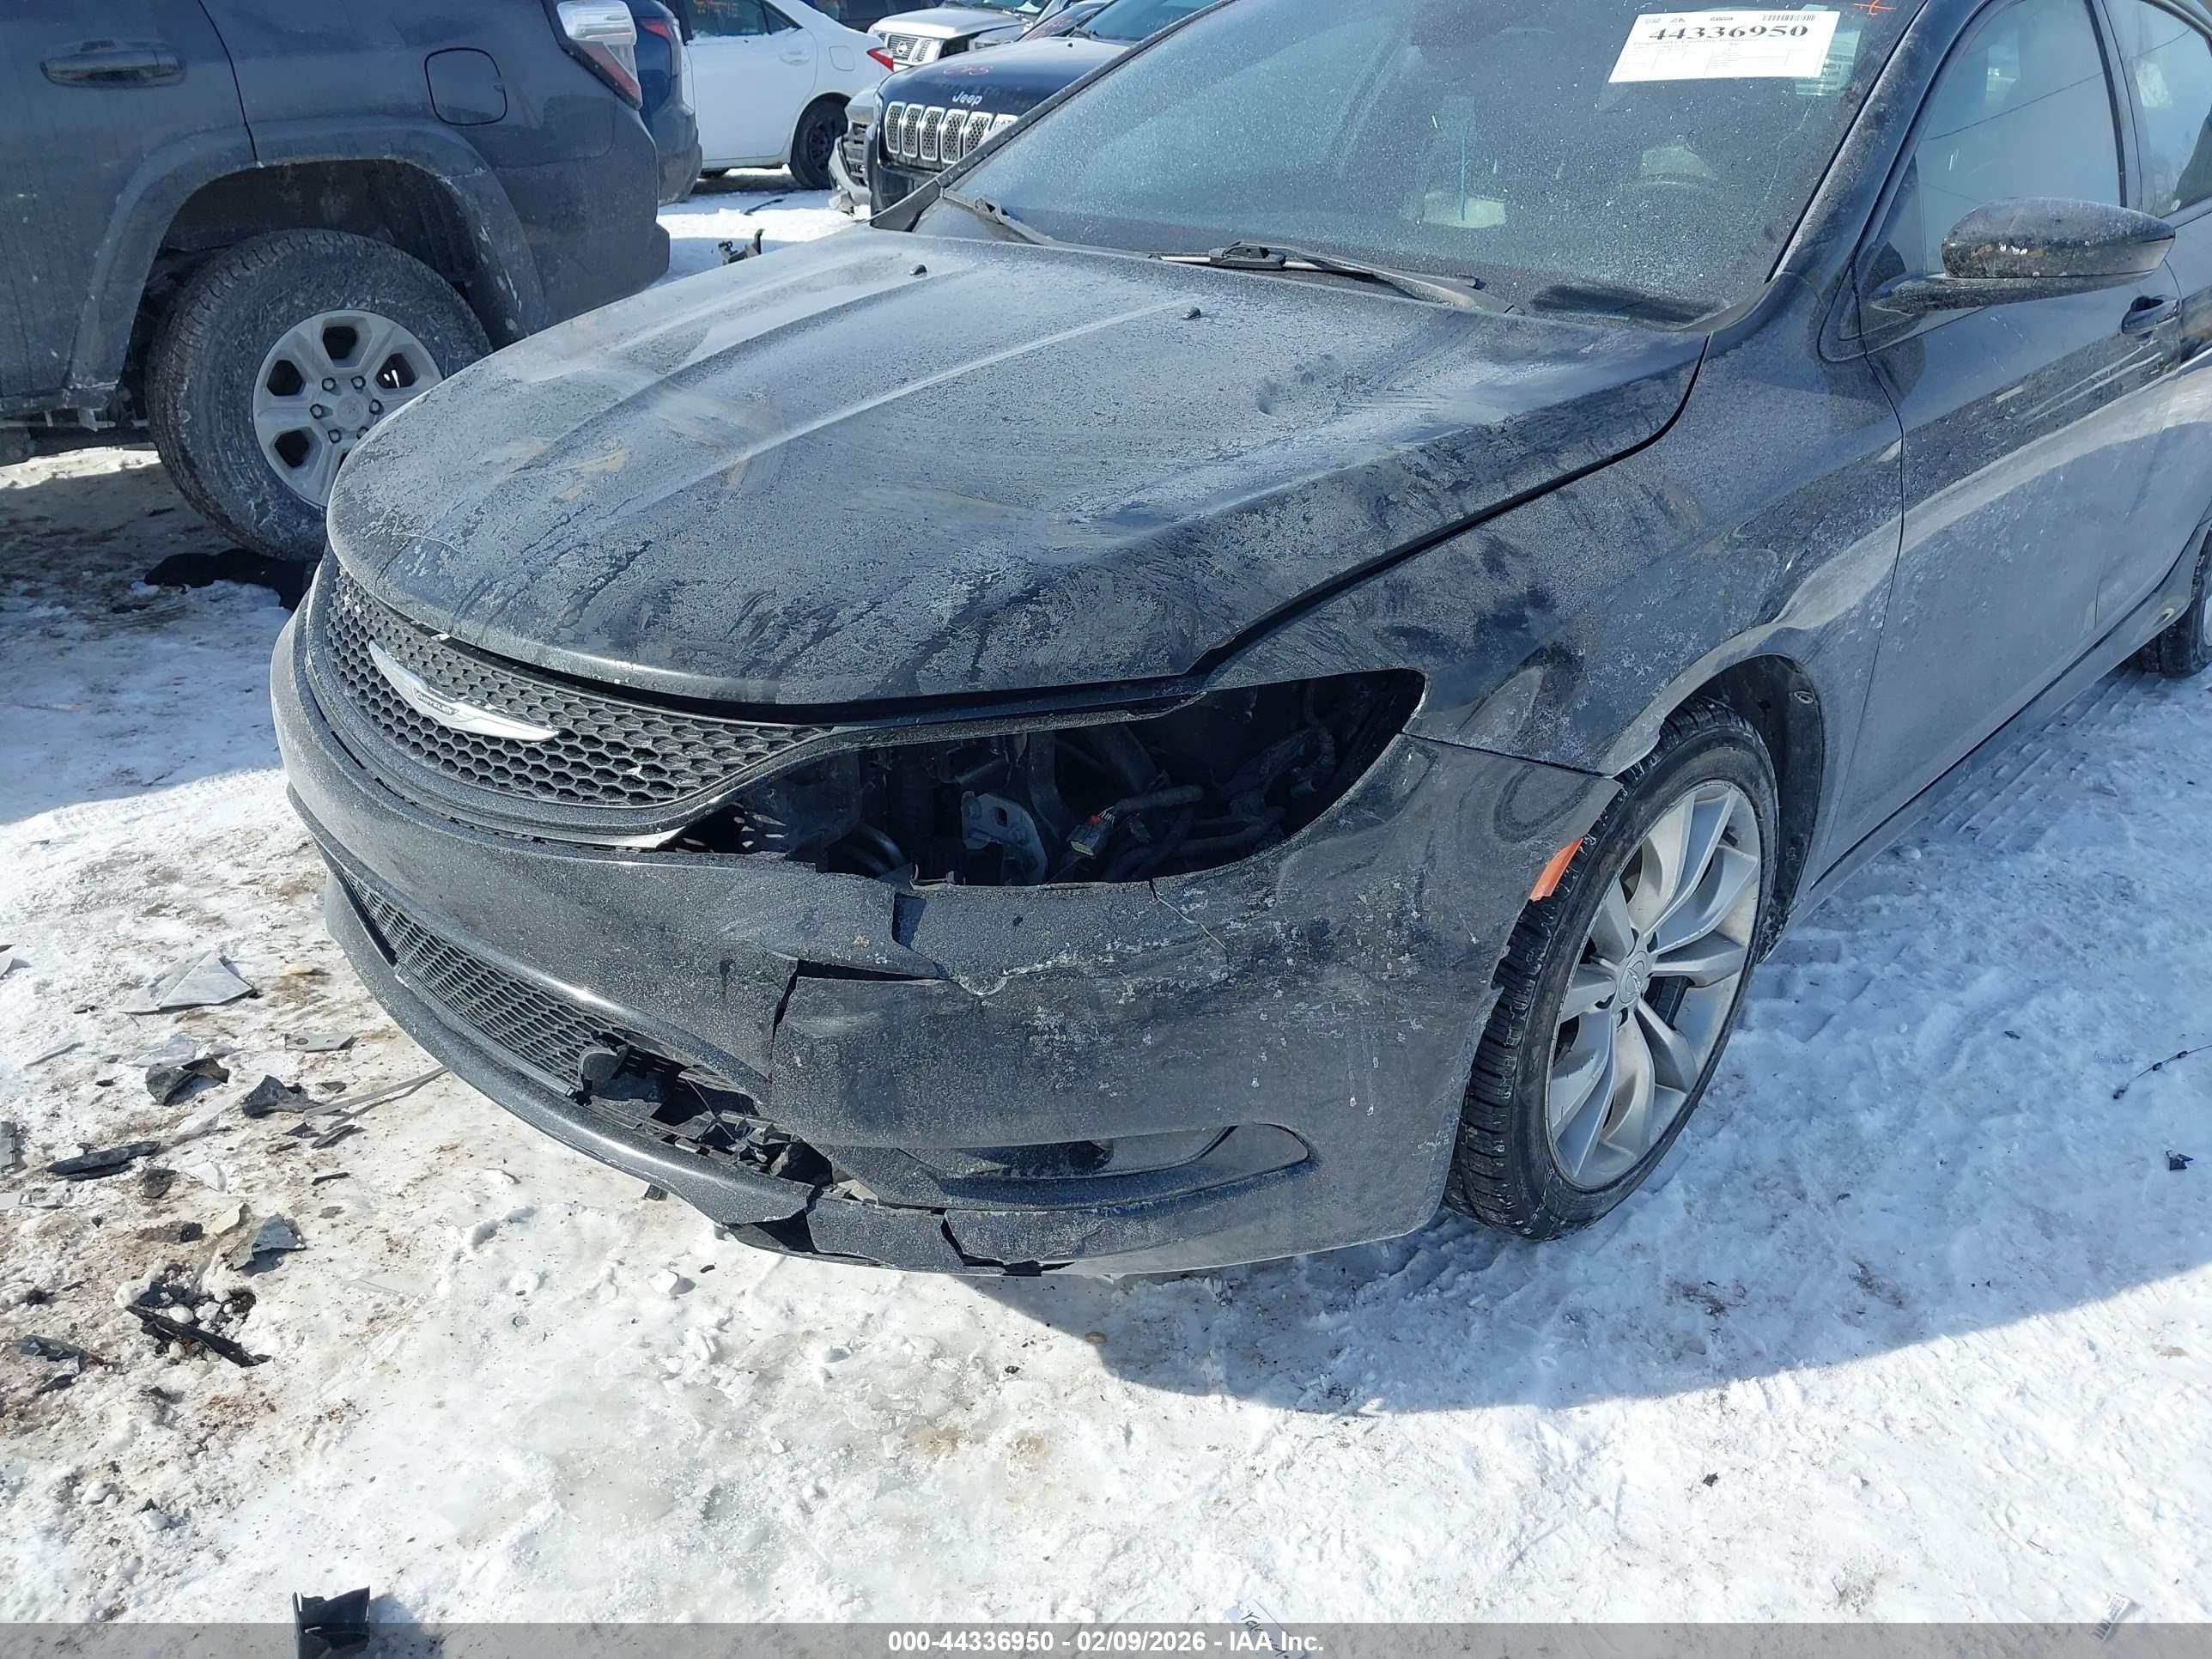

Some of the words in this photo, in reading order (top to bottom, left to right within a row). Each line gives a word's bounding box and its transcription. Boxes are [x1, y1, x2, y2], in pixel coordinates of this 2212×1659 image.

[1649, 25, 1808, 40] 44336950
[952, 91, 983, 106] Jeep
[416, 692, 455, 714] CHRYSLER
